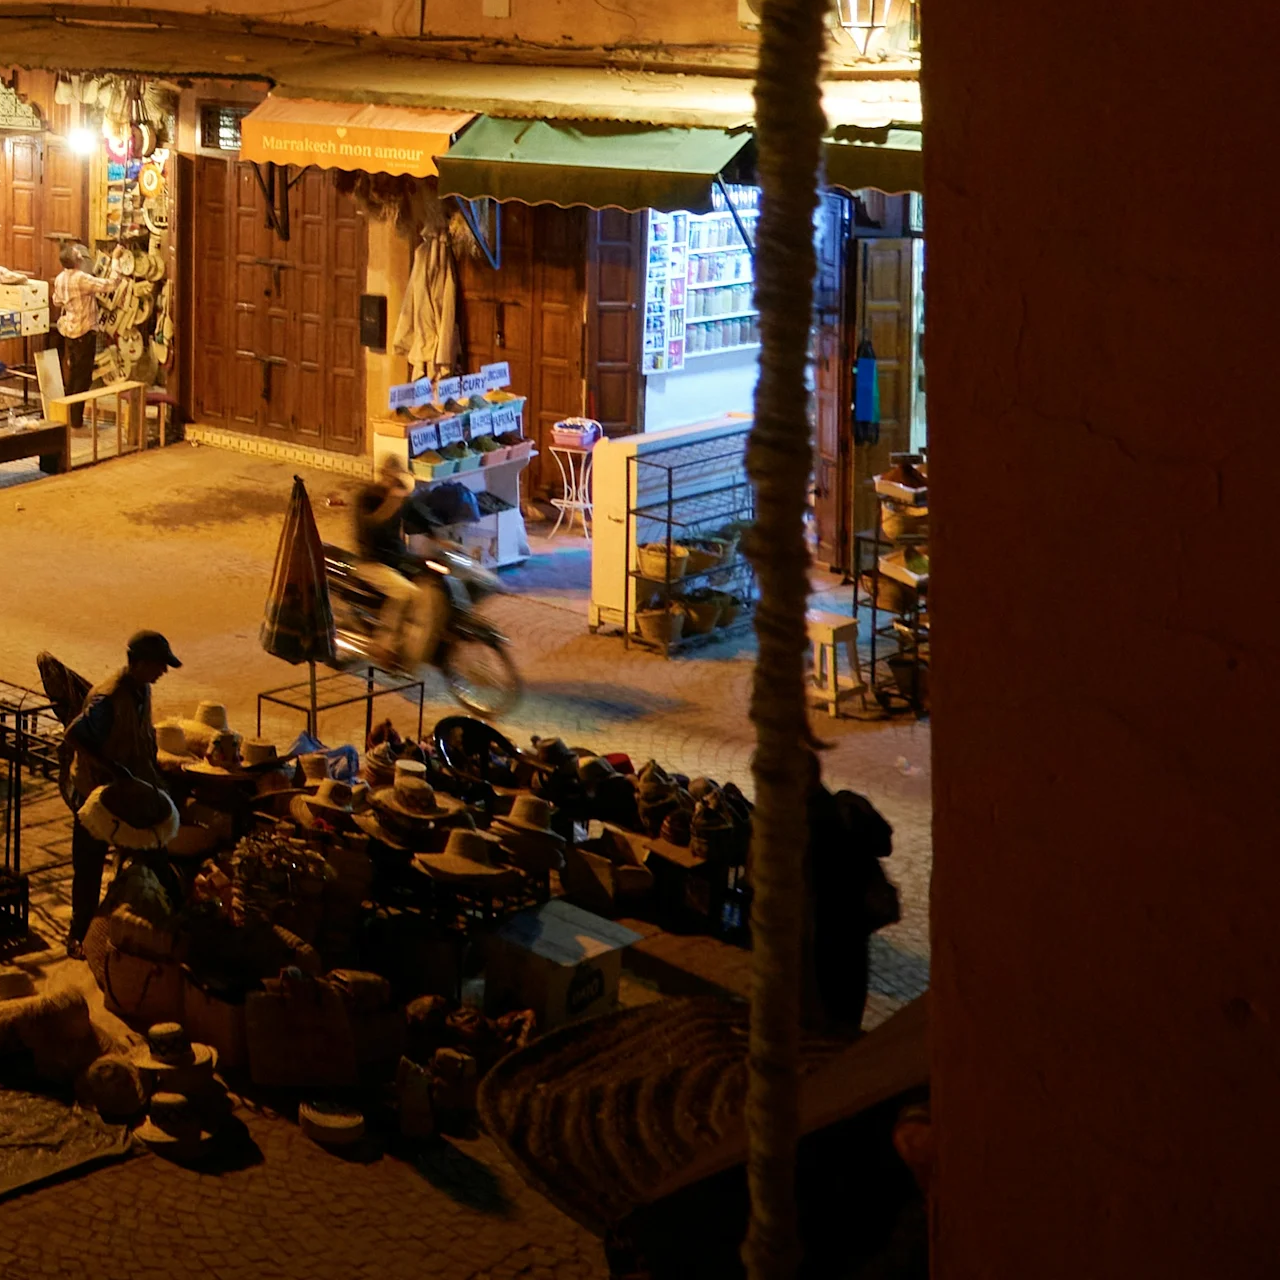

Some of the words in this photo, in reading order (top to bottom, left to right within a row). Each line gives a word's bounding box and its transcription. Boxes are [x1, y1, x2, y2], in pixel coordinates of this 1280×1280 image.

[262, 135, 337, 154] Marrakech
[339, 140, 372, 157] mon
[374, 144, 424, 162] amour
[462, 376, 487, 392] CURY
[413, 431, 437, 448] CUMIN
